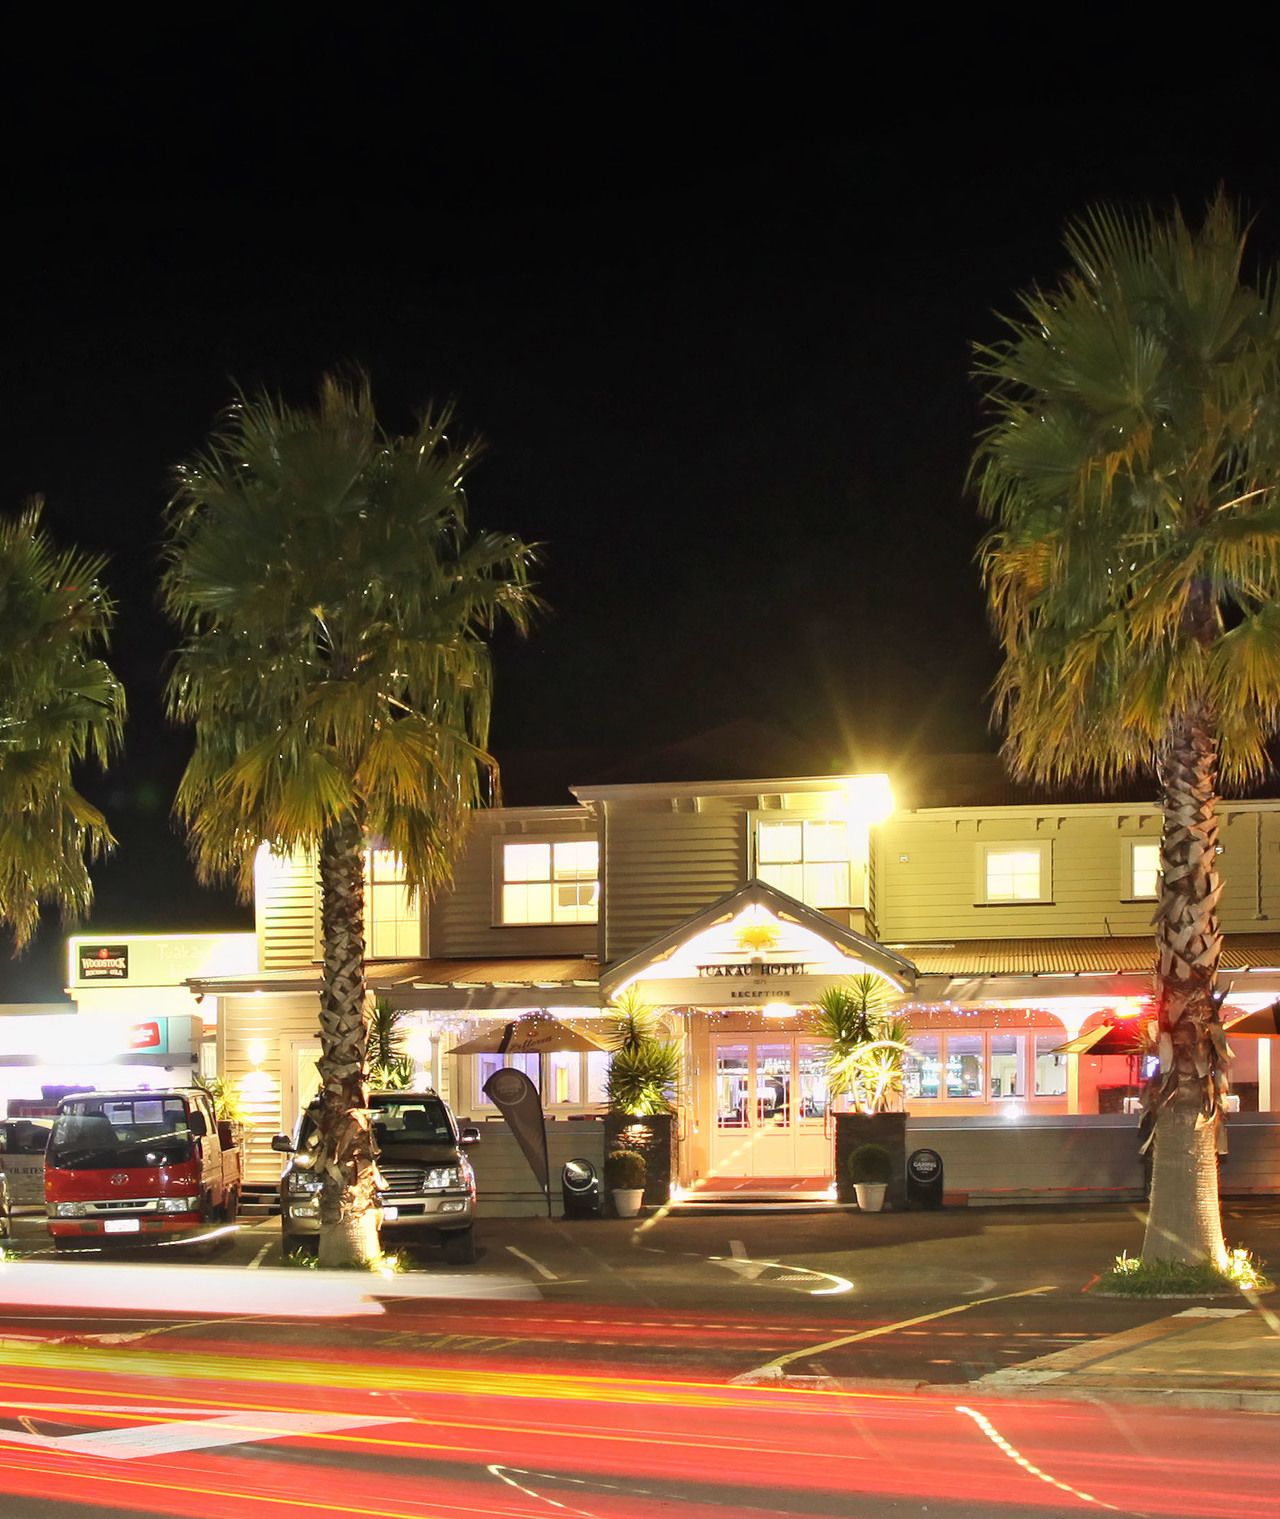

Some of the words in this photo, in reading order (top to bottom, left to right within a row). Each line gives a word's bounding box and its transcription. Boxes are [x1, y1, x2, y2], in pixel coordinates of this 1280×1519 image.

[81, 957, 126, 969] WOODSTOCK
[696, 964, 752, 977] TUAKAU
[761, 963, 809, 976] HOTEL
[731, 990, 791, 998] RECEPTION
